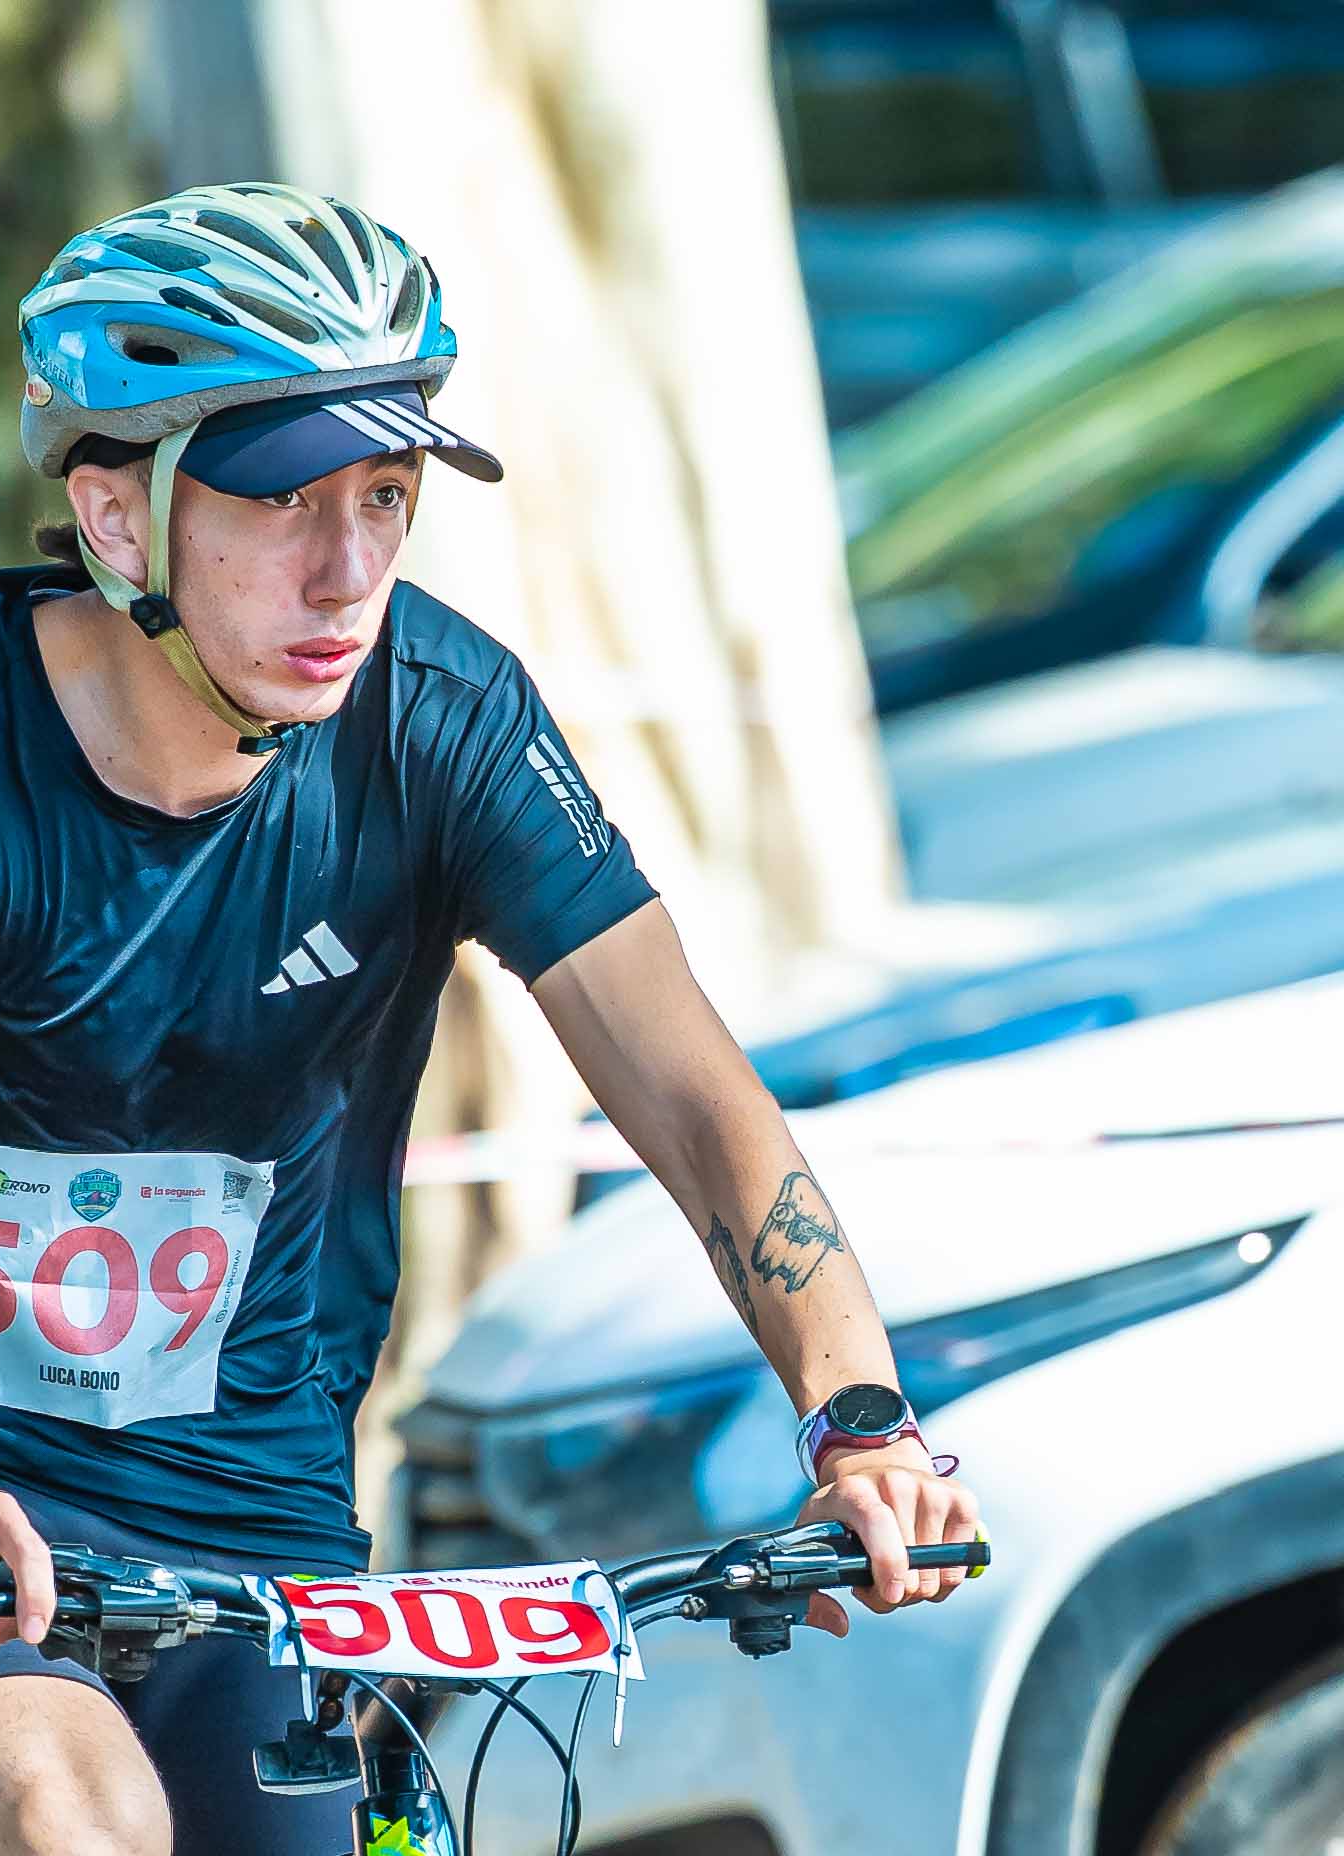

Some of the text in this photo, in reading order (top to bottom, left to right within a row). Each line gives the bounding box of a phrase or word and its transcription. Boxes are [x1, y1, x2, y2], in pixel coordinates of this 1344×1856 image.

[39, 1364, 120, 1391] LUCA BONO
[277, 1580, 611, 1669] 509
